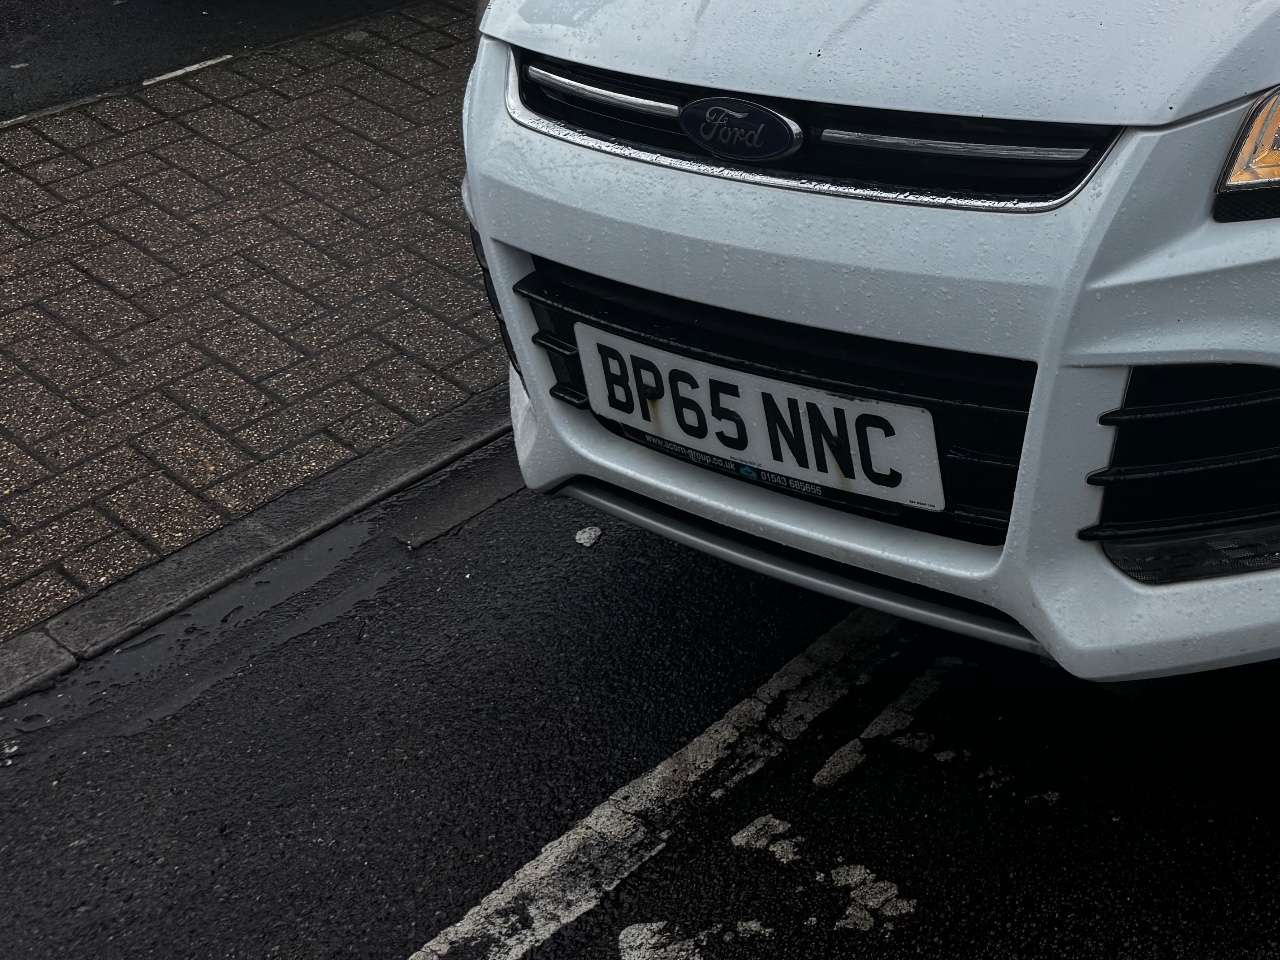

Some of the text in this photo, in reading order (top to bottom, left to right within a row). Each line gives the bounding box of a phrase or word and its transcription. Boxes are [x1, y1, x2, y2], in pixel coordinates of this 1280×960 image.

[700, 106, 767, 148] Ford
[597, 343, 903, 488] BP65 NNC
[760, 471, 788, 487] 01543
